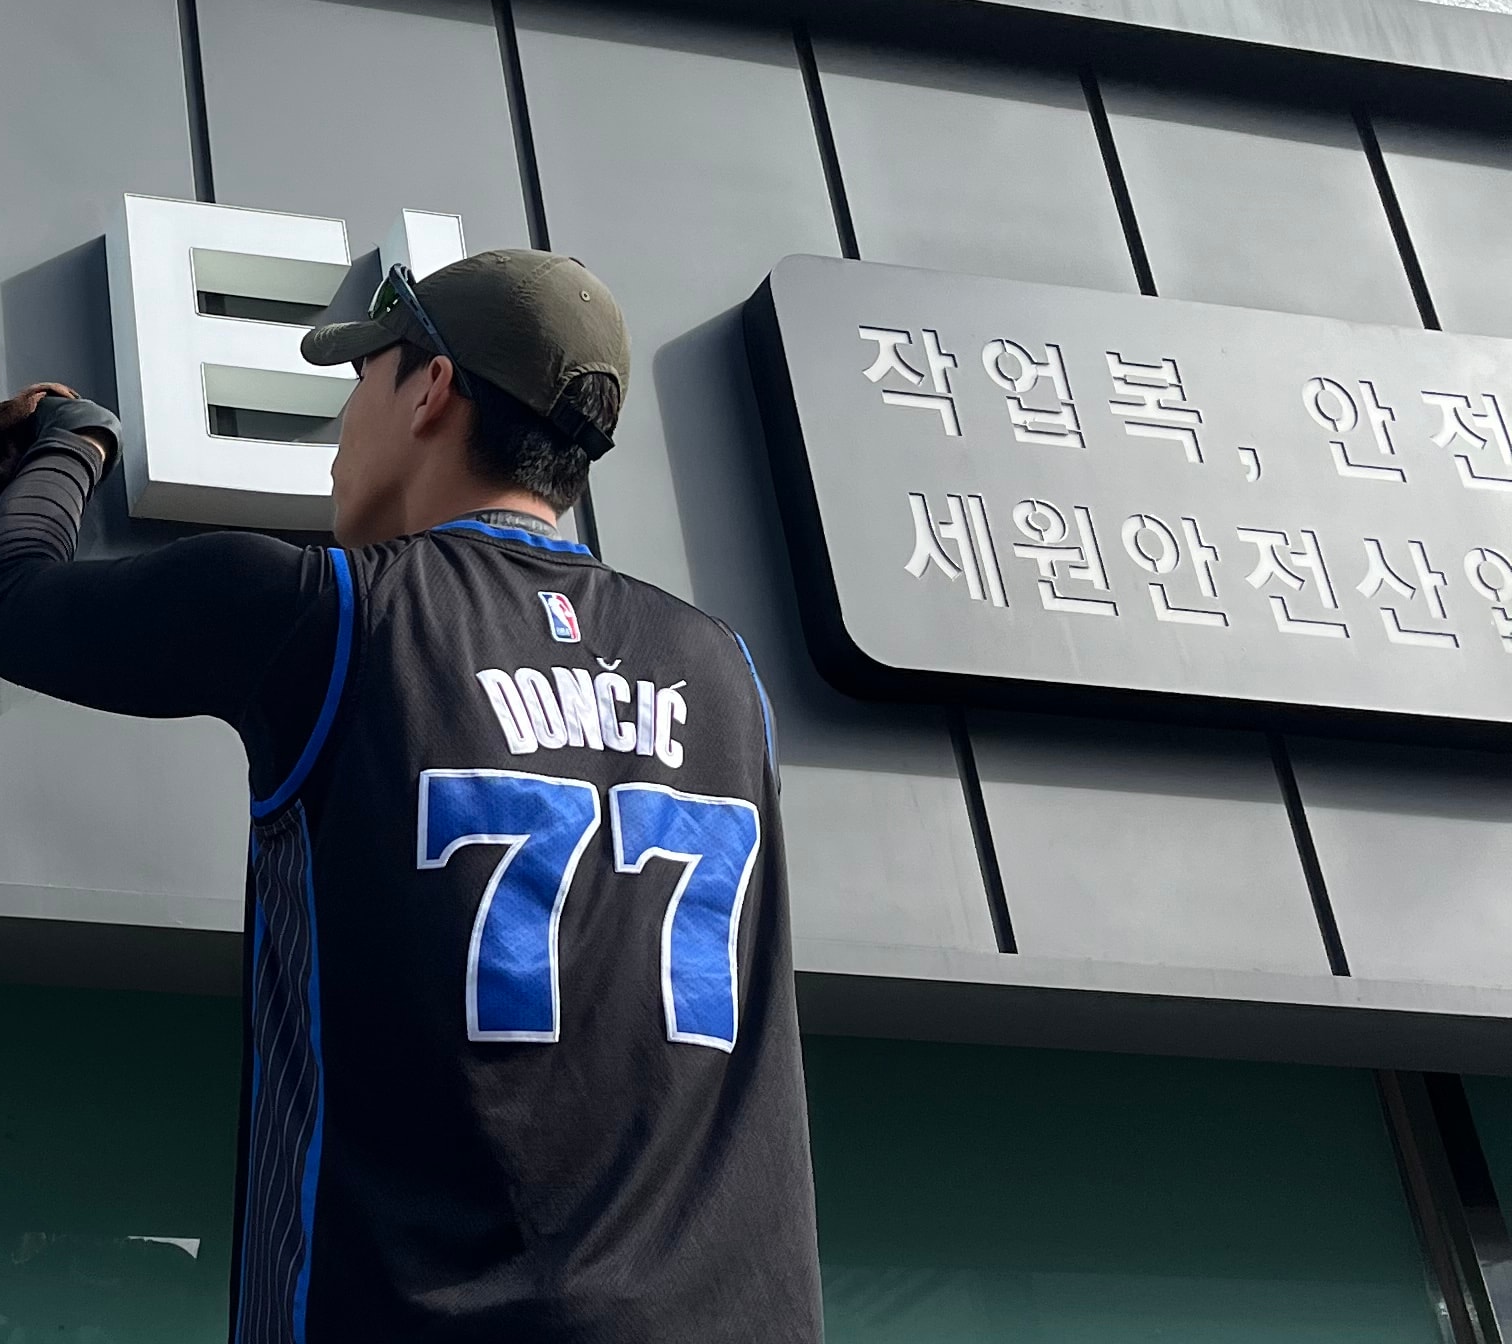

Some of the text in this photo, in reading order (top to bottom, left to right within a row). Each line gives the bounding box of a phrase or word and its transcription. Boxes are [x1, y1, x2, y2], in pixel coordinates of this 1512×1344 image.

[859, 324, 1263, 483] 작업복,
[475, 657, 688, 769] DONČIĆ
[417, 768, 761, 1054] 77
